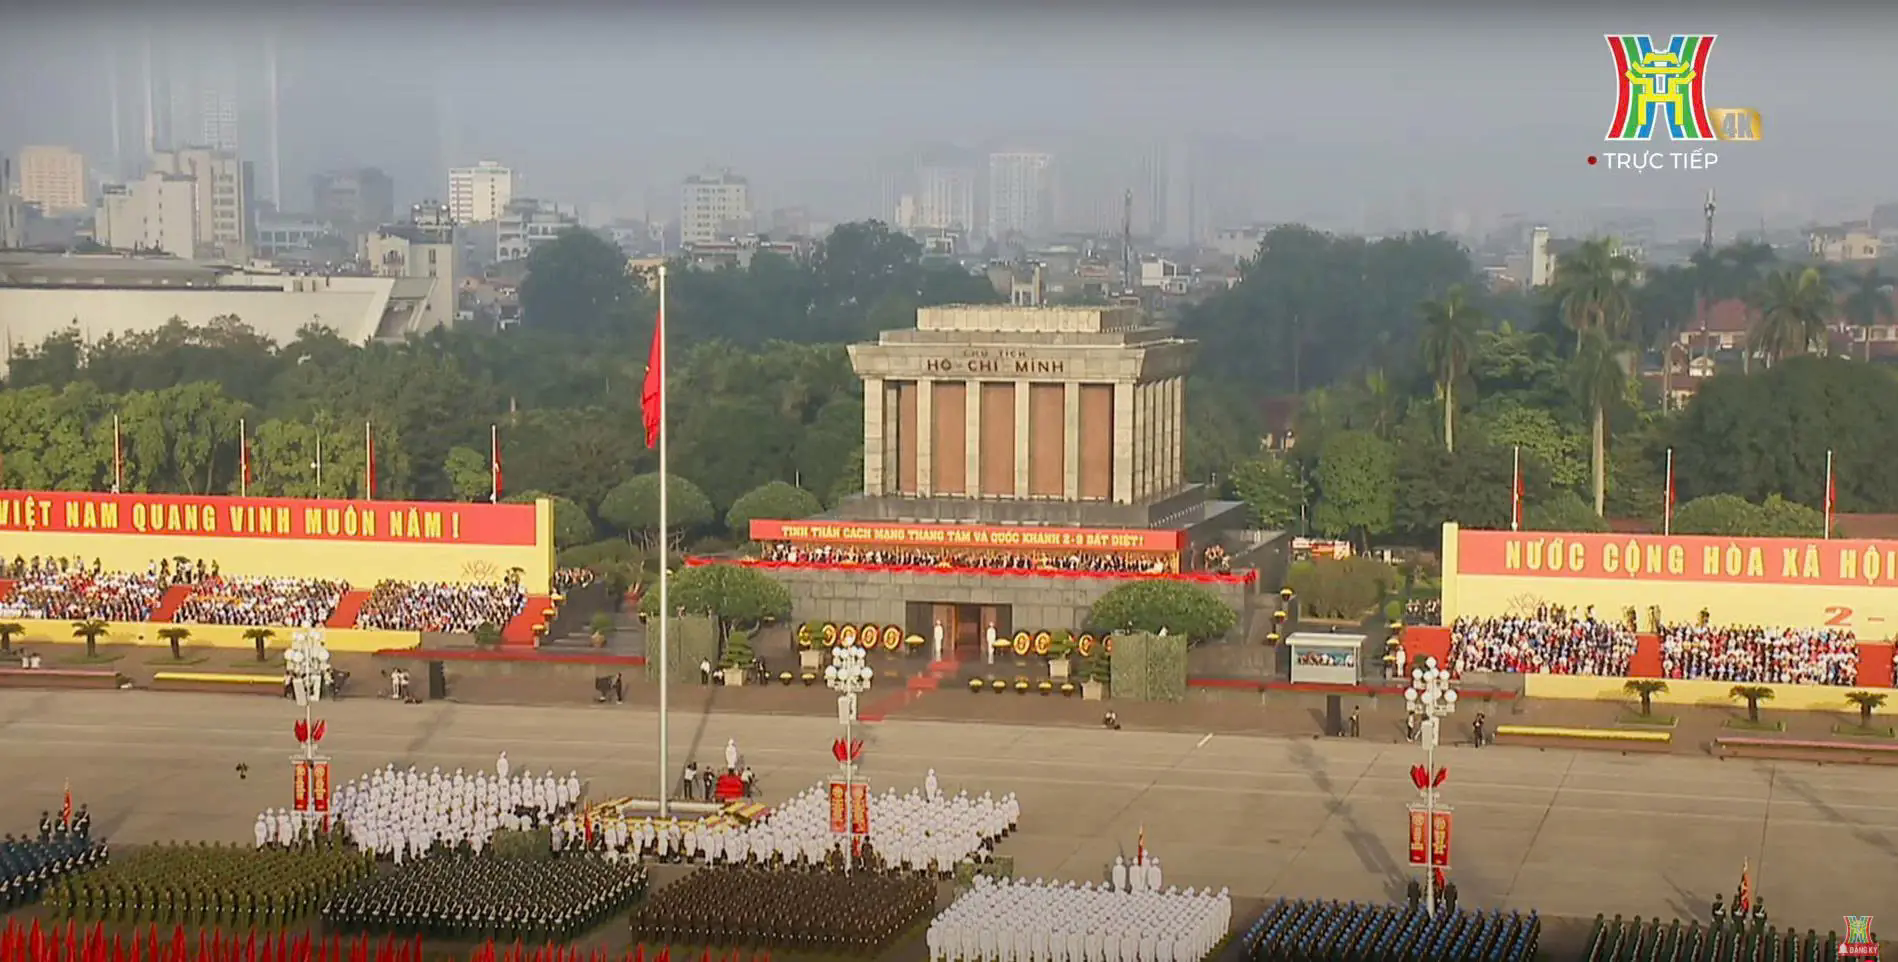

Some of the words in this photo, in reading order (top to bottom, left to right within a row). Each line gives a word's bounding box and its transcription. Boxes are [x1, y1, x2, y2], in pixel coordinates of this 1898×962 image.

[0, 496, 52, 531] VIỆT
[66, 501, 119, 528] NAM
[132, 503, 217, 532] QUANG
[230, 506, 290, 533] VINH
[305, 504, 376, 537] MUÔN
[389, 507, 443, 538] NĂM
[1505, 537, 1585, 572] NƯỚC
[1603, 539, 1685, 578] CỘNG
[1703, 542, 1765, 577] HÒA
[1782, 544, 1821, 577] XÃ
[1839, 544, 1897, 585] HỘI
